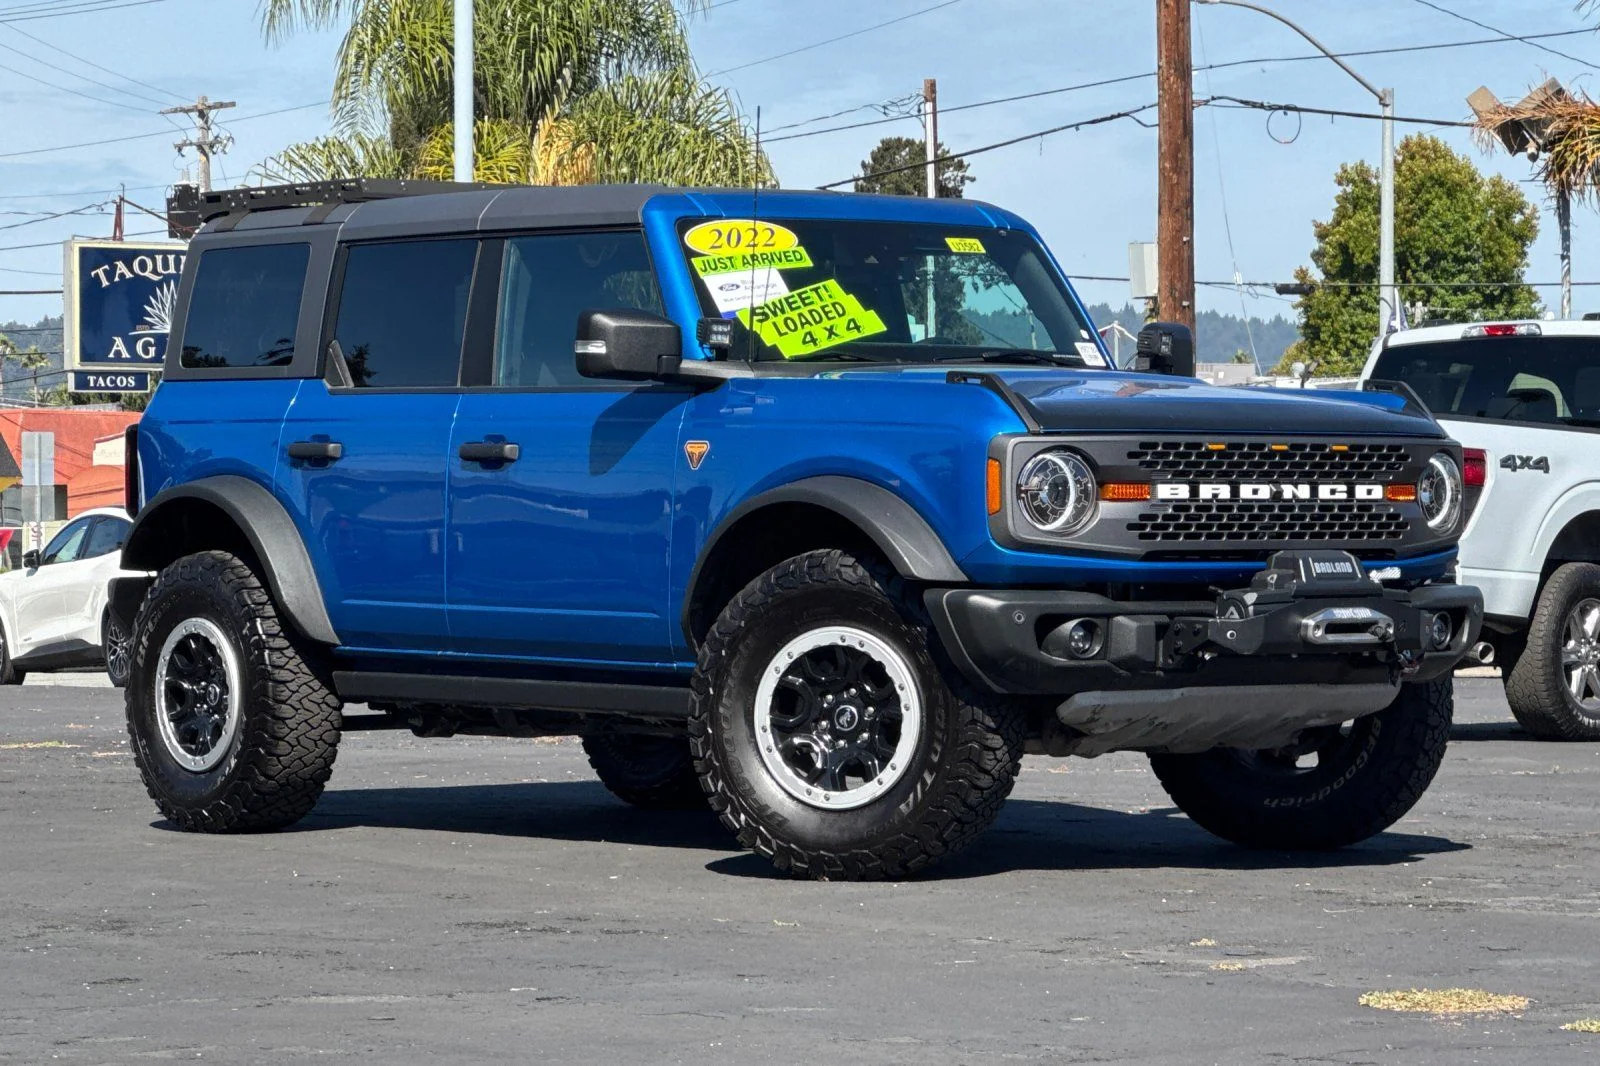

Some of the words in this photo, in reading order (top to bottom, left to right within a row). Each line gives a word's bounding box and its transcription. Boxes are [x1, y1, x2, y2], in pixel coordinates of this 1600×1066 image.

[709, 227, 776, 249] 2022
[700, 256, 735, 273] JUST
[742, 249, 804, 267] ARRIVED
[753, 284, 833, 323] SWEET!
[772, 301, 846, 337] LOADED
[108, 336, 168, 359] AG
[87, 375, 136, 387] TACOS
[1157, 483, 1384, 499] BRONCO
[1314, 562, 1353, 573] BADLAND
